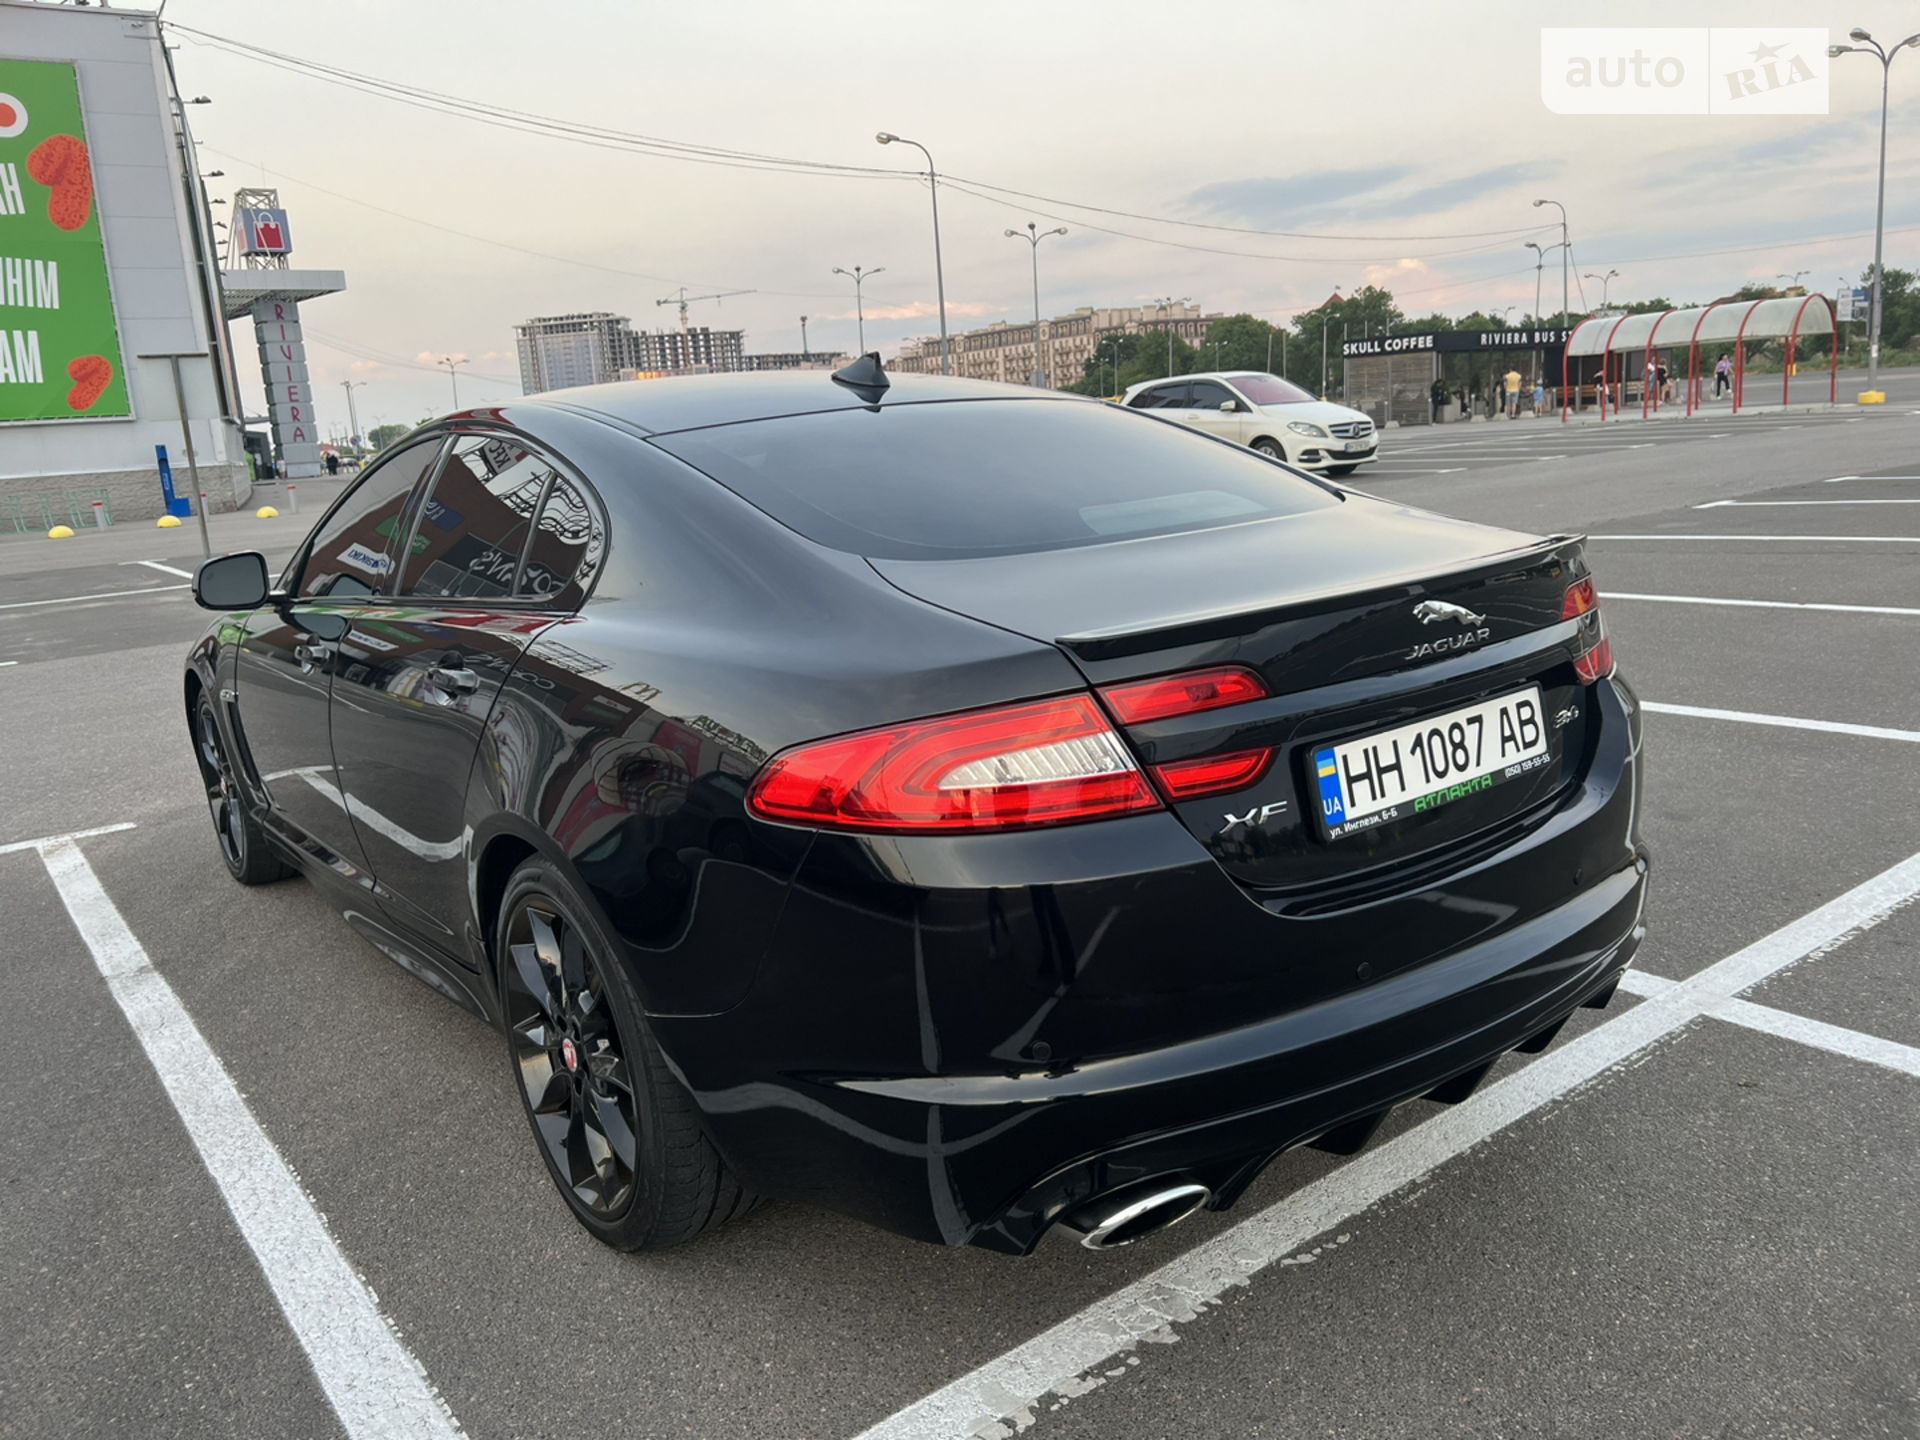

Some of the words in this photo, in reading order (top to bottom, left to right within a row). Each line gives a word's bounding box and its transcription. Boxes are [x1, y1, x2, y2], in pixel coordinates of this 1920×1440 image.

[1343, 341, 1381, 356] SKULL
[1384, 335, 1434, 352] COFFEE
[1480, 332, 1528, 346] RIVIERA
[1534, 330, 1555, 344] BUS
[274, 303, 306, 443] RIVIERA
[1404, 627, 1490, 660] JAGUAR
[1341, 739, 1406, 808] HH
[1410, 714, 1484, 785] 1087
[1499, 699, 1540, 758] AB
[1323, 796, 1343, 816] UA
[1414, 773, 1493, 812] АТЛАНТА
[1219, 800, 1288, 834] XF
